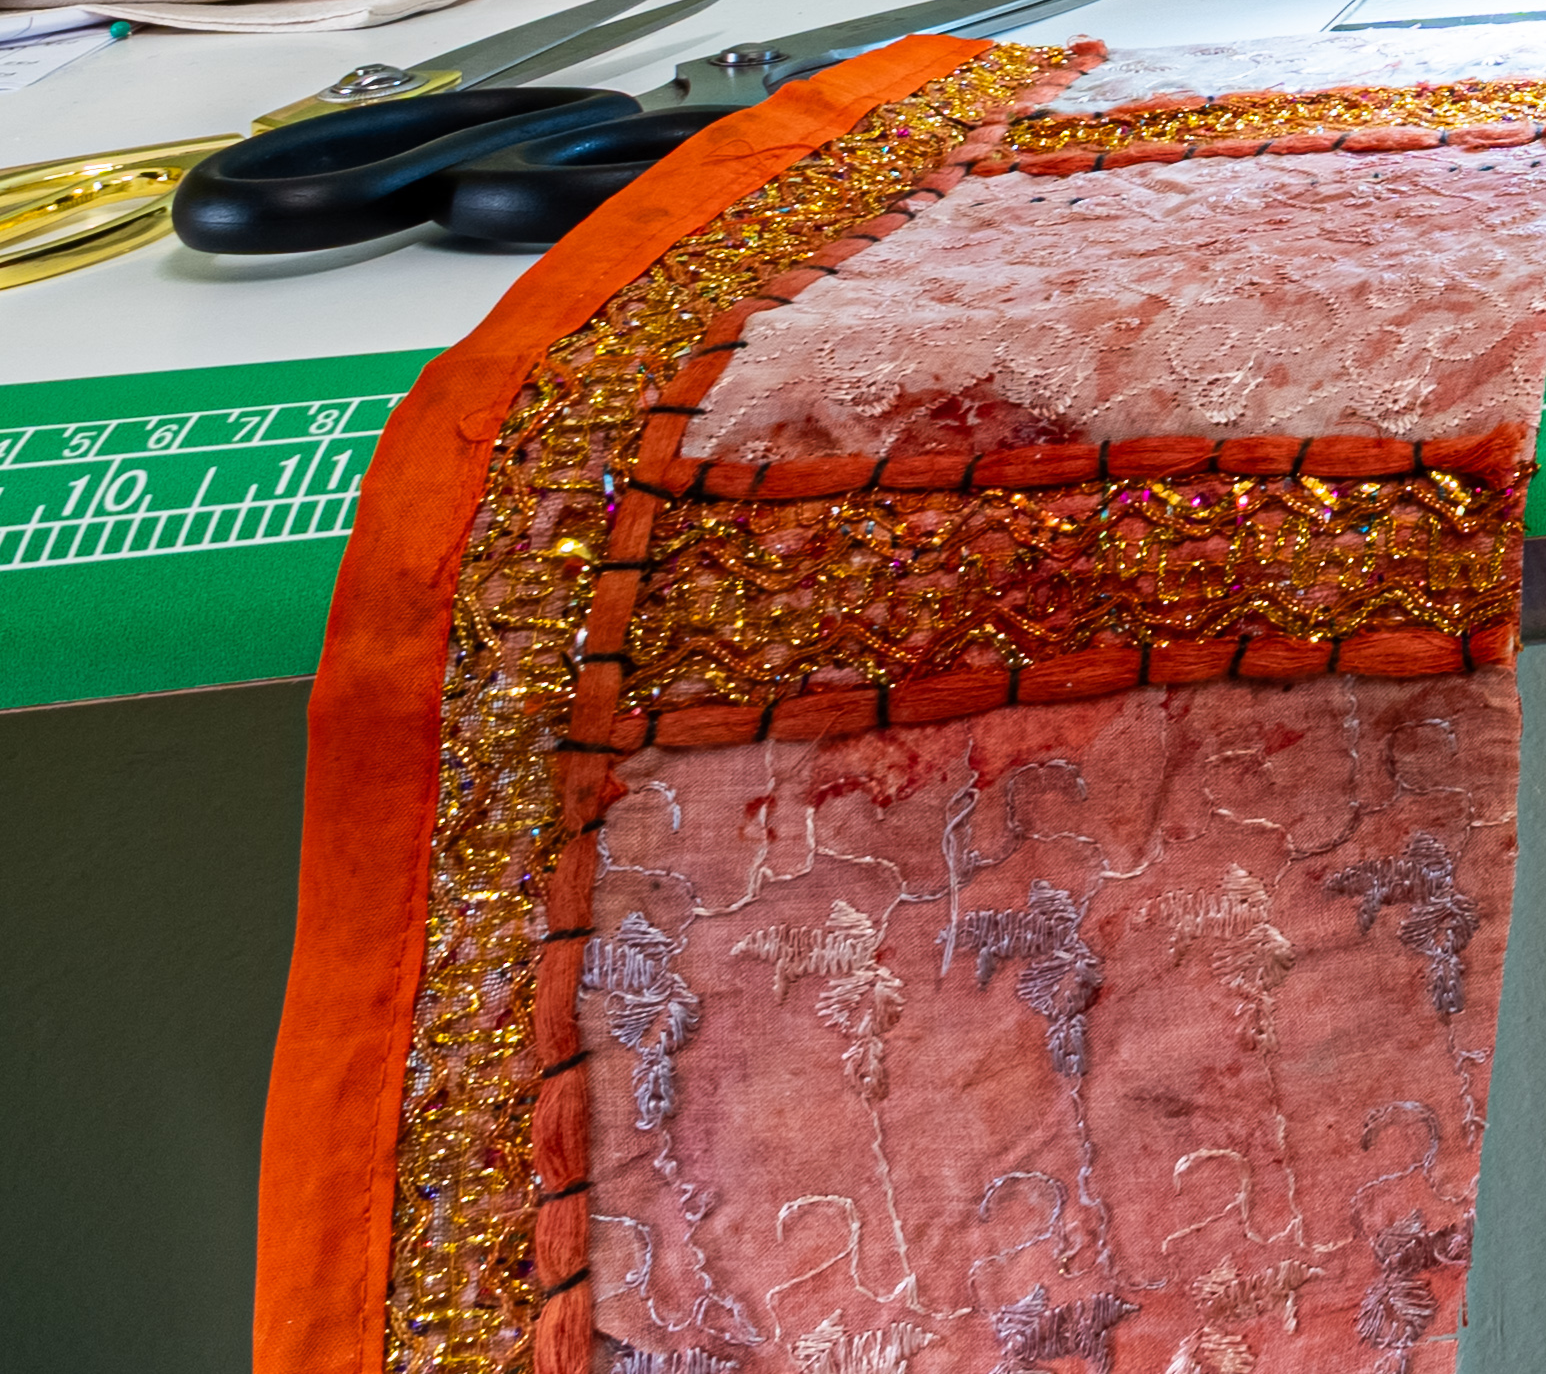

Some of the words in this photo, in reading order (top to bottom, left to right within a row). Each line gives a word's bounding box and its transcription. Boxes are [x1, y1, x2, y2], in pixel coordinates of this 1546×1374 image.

[62, 431, 98, 458] 5
[147, 424, 178, 449] 6
[232, 416, 261, 442] 7
[308, 409, 340, 435] 8
[61, 469, 148, 516] 10
[274, 449, 353, 495] 11
